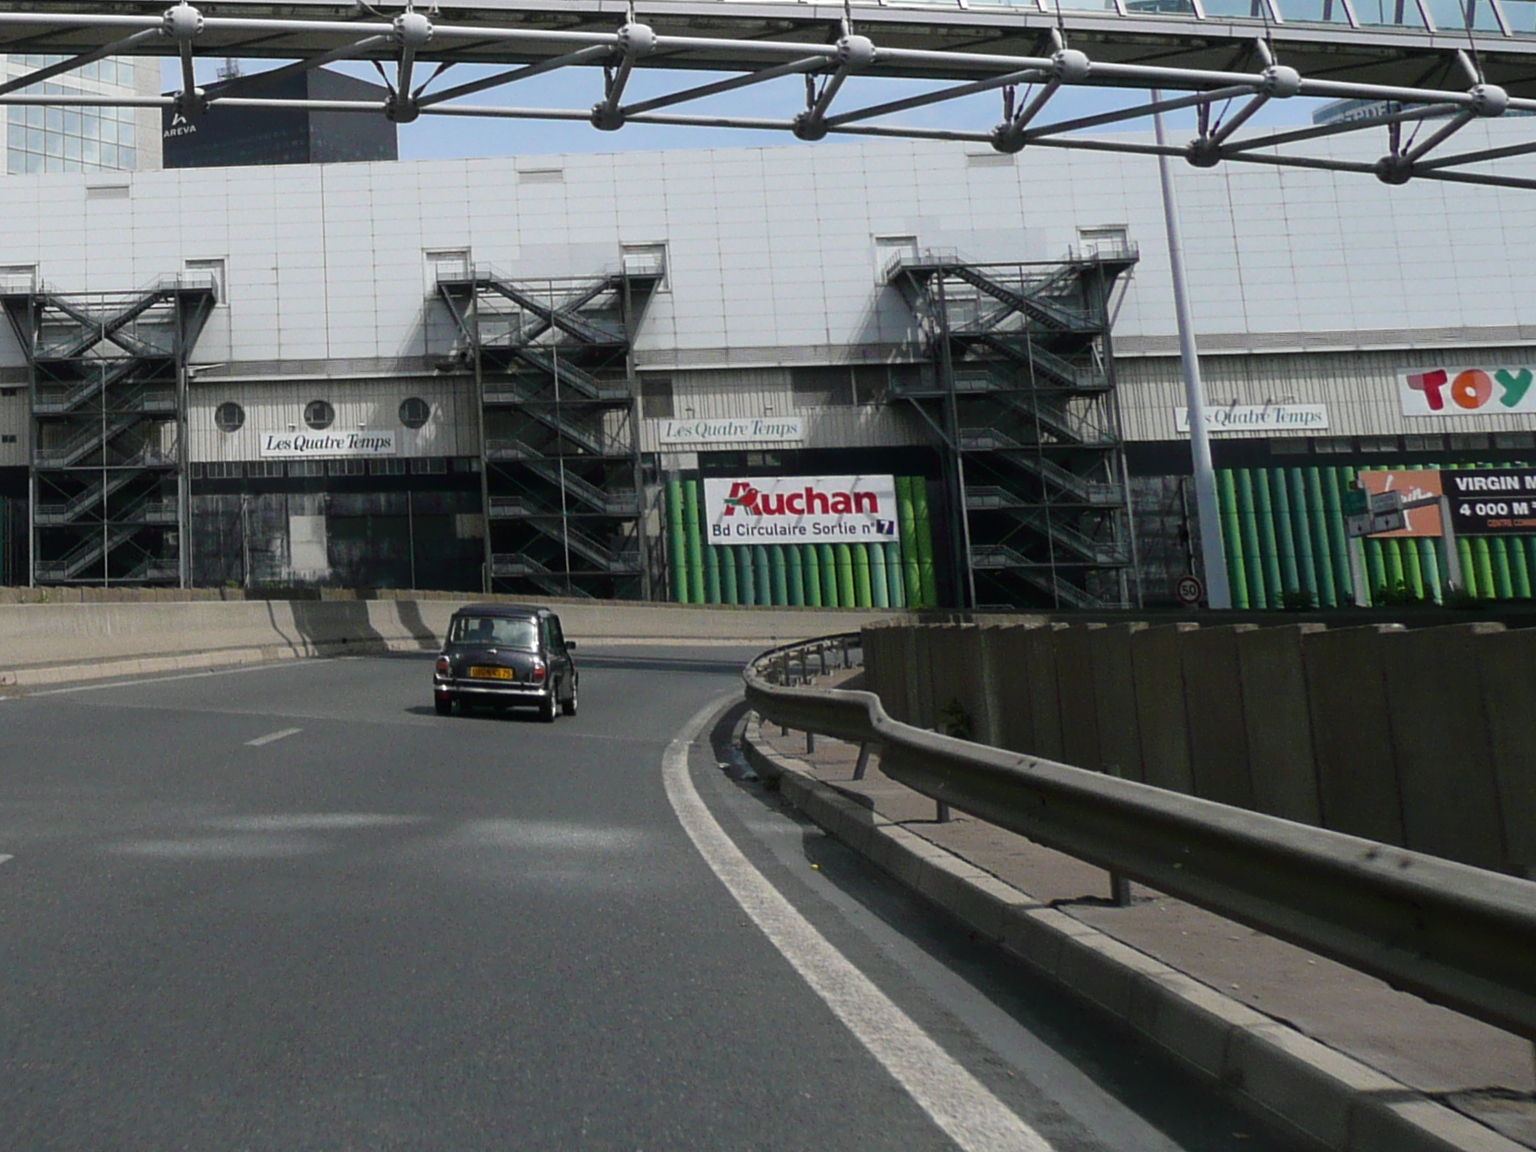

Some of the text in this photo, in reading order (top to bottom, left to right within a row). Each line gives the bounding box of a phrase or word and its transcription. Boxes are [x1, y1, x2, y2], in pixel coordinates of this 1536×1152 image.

[164, 125, 196, 138] AREVA
[1406, 368, 1534, 410] TOY
[1215, 408, 1270, 426] Quatre
[1273, 407, 1322, 425] Temps
[666, 420, 797, 438] Les Quatre Temps
[266, 433, 391, 452] Les Quatre Temps
[1455, 476, 1520, 491] VIRGIN
[724, 482, 879, 516] Auchan
[713, 524, 730, 536] Bd
[736, 523, 806, 536] Circulaire
[812, 522, 856, 535] Sortie
[1182, 584, 1196, 596] 50
